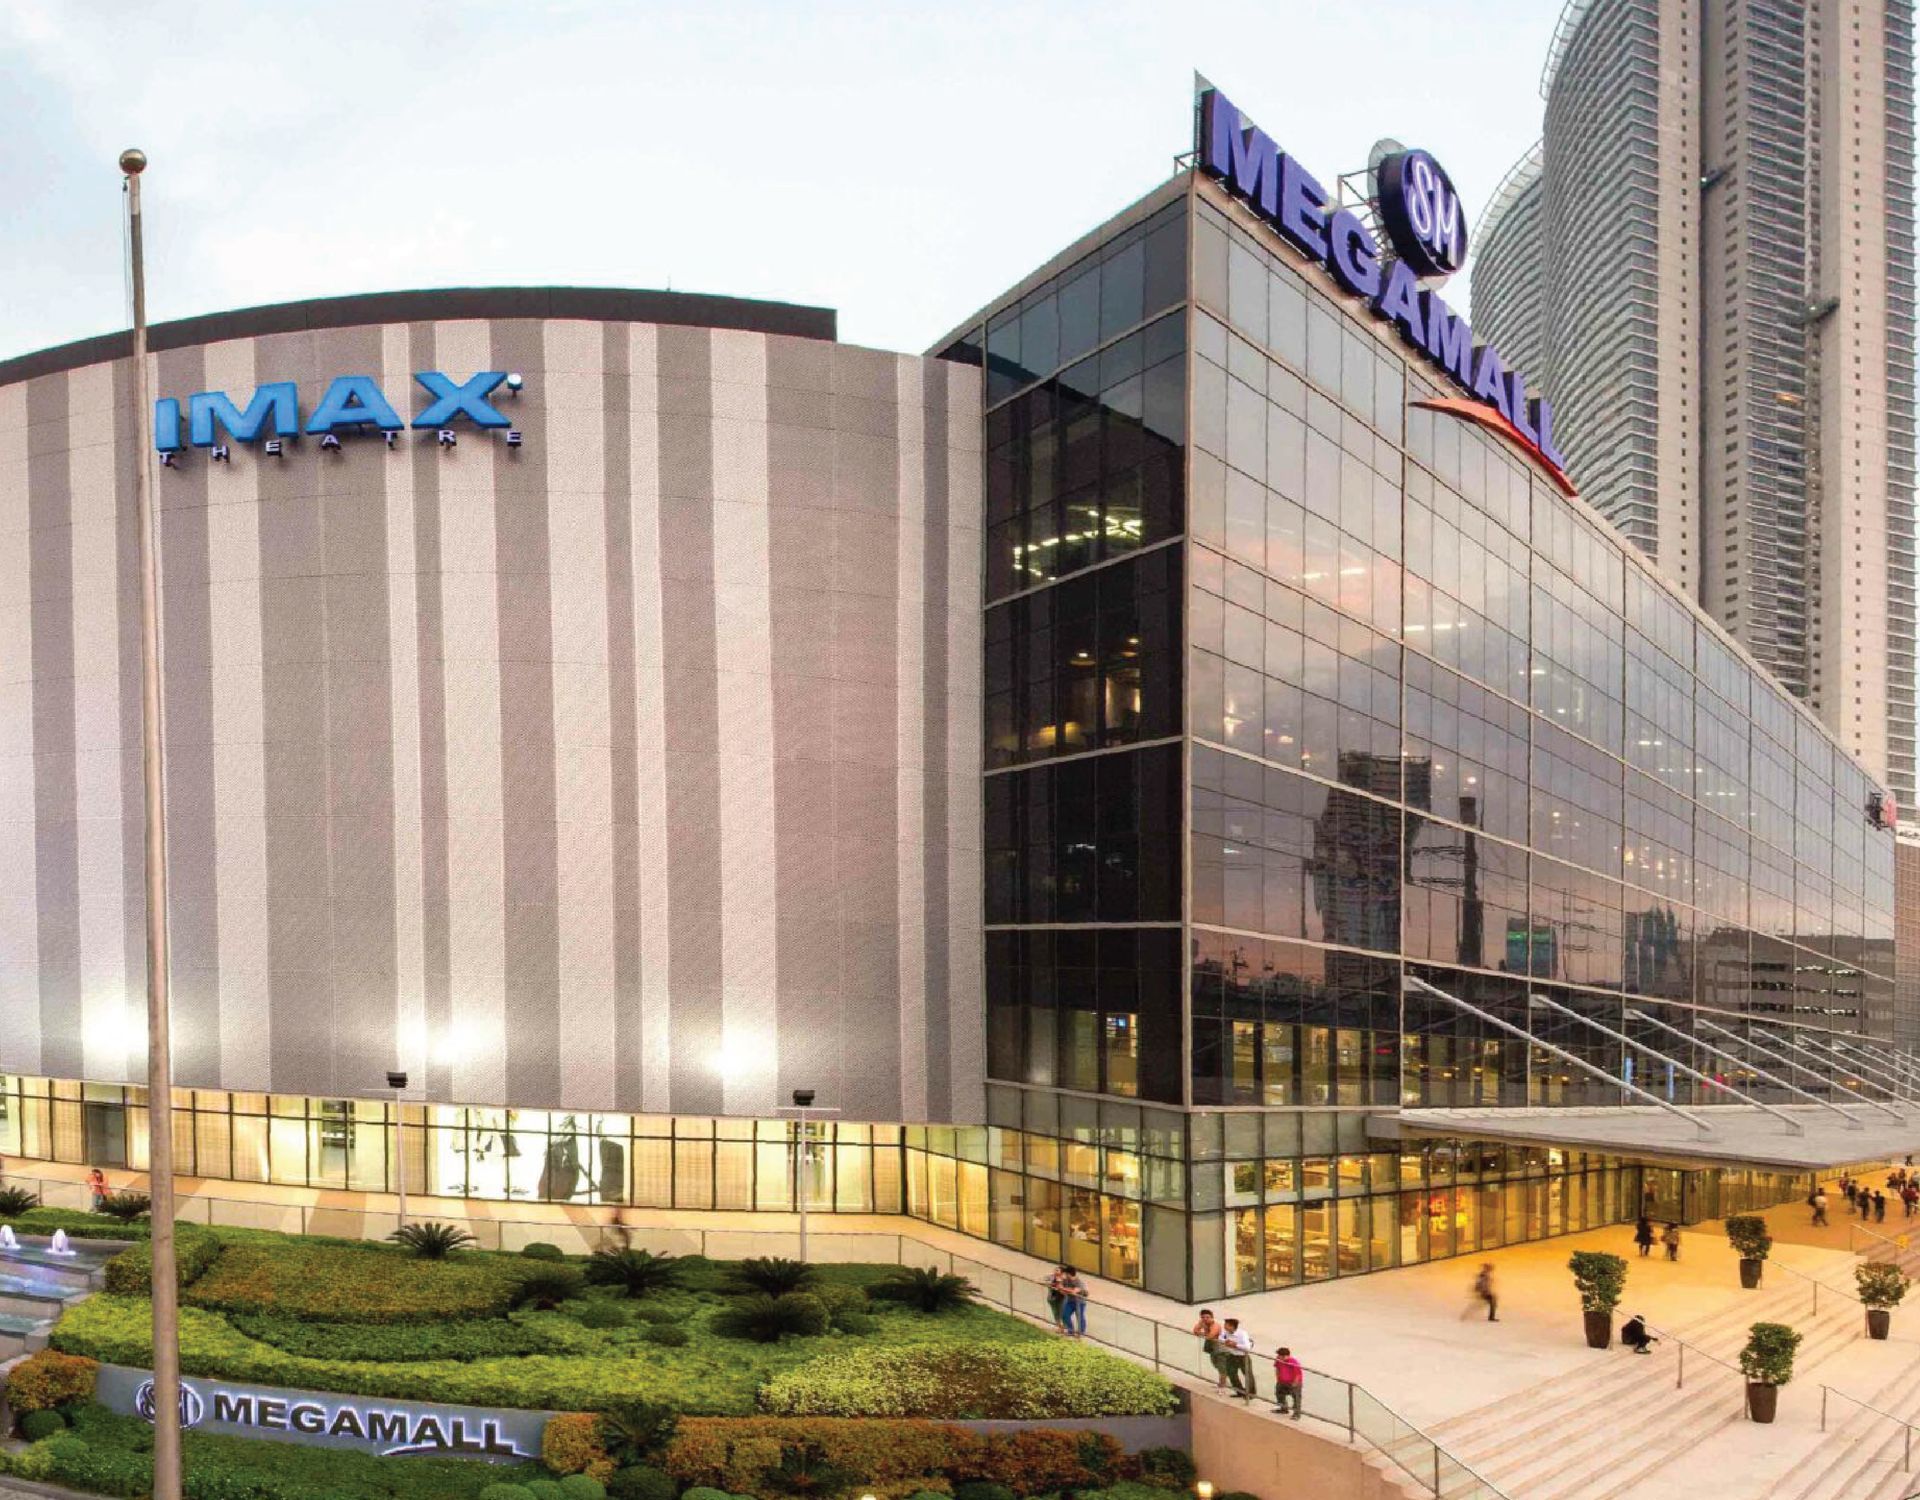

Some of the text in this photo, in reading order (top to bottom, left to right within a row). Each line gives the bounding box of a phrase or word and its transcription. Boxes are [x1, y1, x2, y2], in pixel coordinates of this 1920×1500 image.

[1403, 153, 1460, 268] SM
[1201, 87, 1564, 472] MEGAMALL
[155, 371, 512, 452] IMAX
[158, 430, 523, 464] THEATRE
[213, 1393, 515, 1455] MEGAMALL
